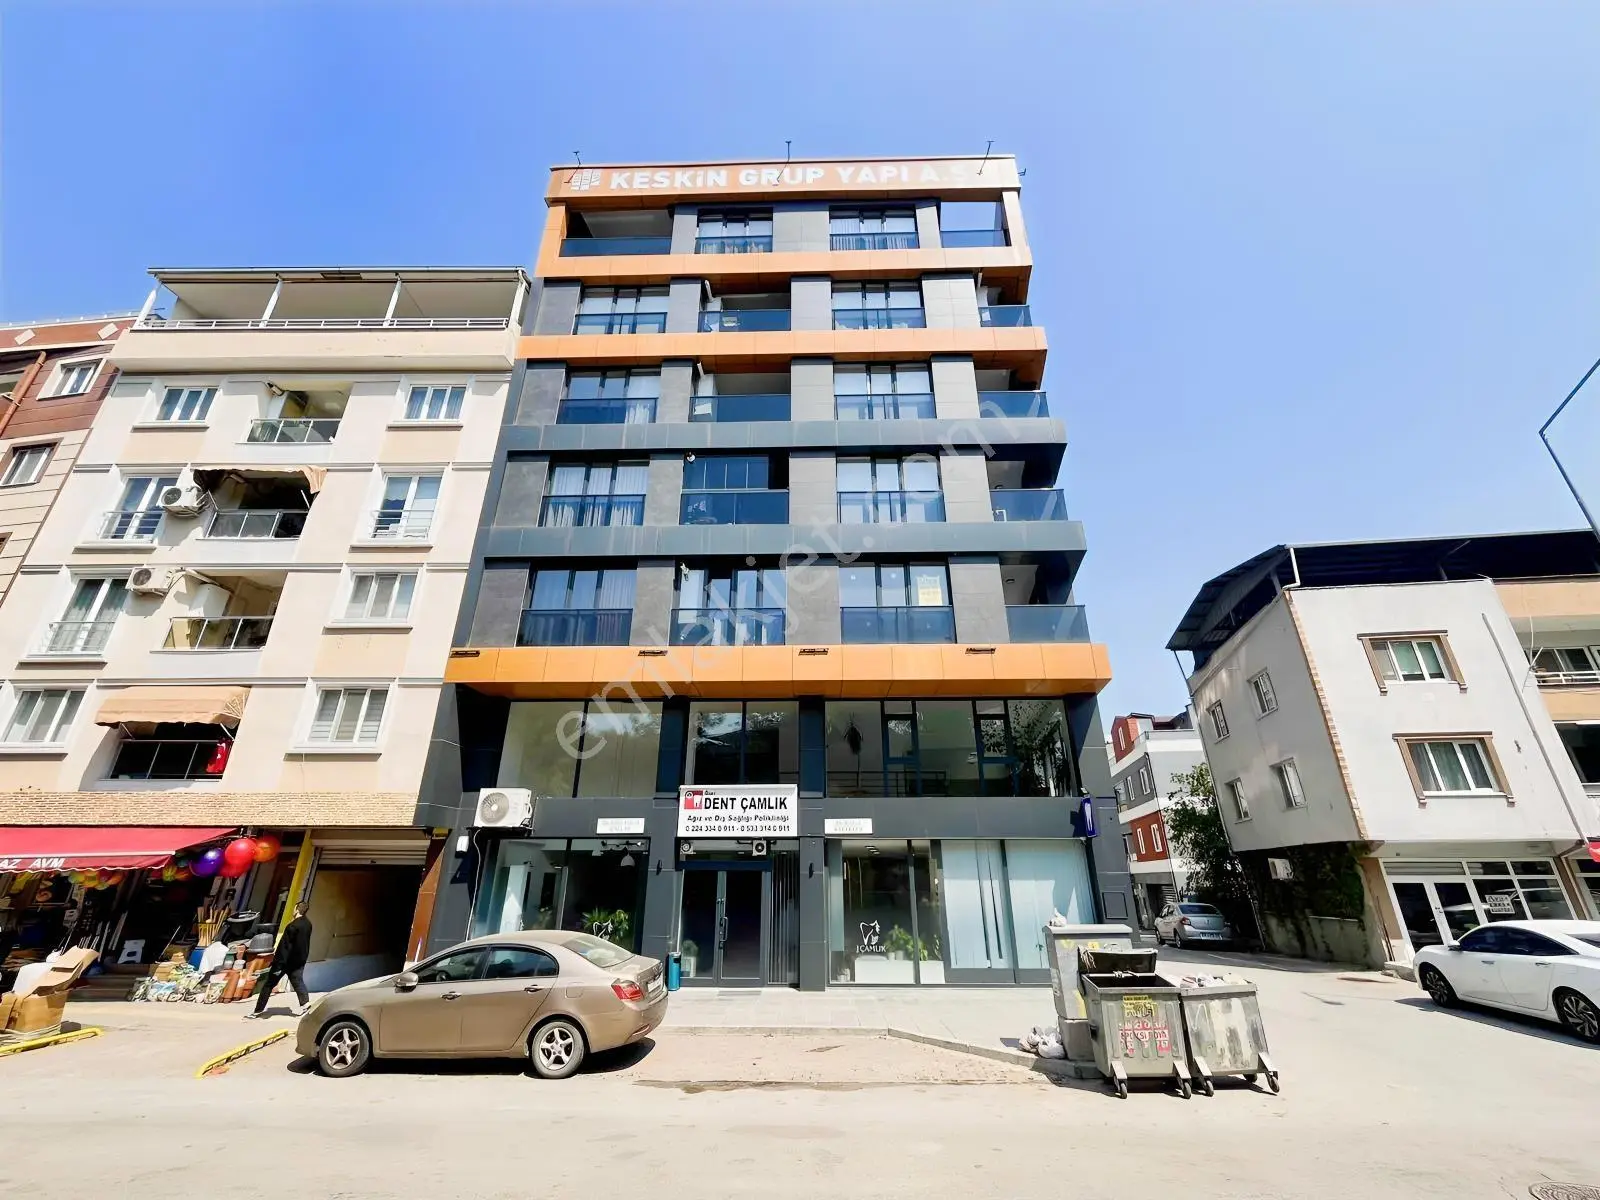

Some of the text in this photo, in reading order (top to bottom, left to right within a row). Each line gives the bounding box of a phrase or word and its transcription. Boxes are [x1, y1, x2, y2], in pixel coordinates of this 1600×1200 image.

[739, 166, 825, 187] GRUP
[834, 164, 910, 185] YAPI
[704, 797, 788, 813] DENT ÇAMLIK
[28, 857, 66, 870] AVM
